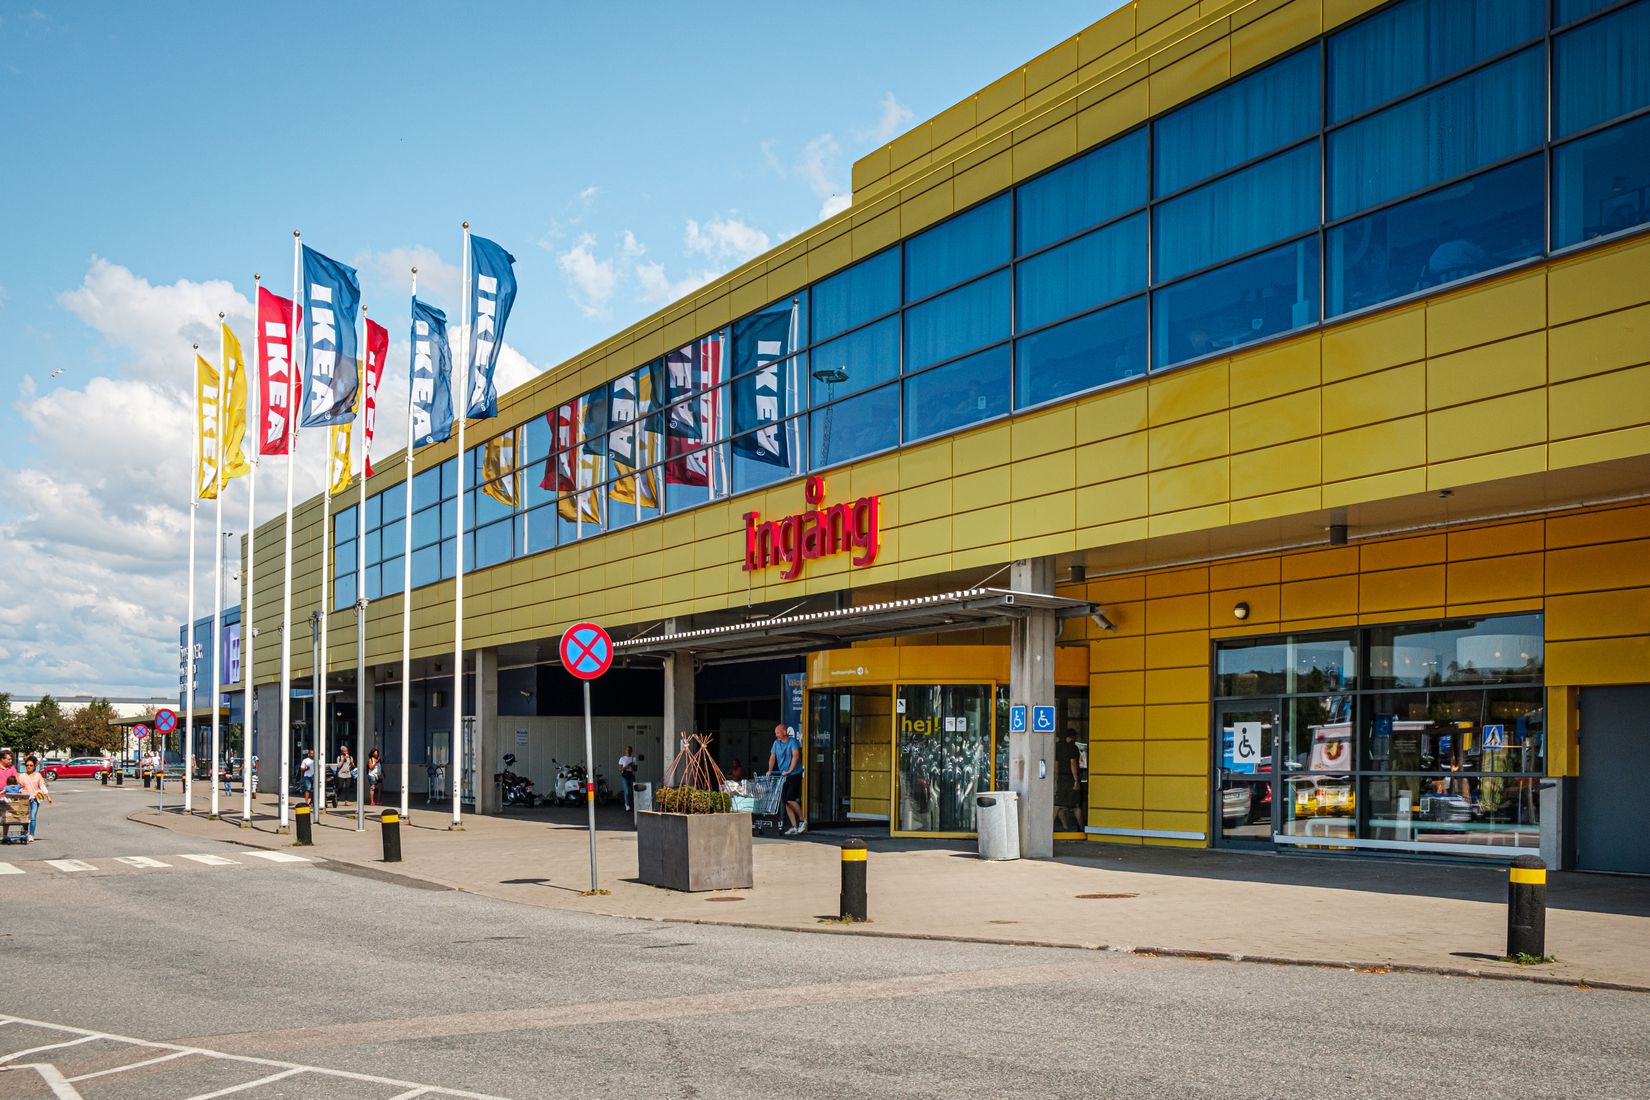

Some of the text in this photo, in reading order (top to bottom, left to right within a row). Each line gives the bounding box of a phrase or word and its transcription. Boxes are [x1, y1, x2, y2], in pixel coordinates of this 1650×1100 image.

[265, 321, 288, 444] IKEA
[311, 283, 336, 417] IKEA
[412, 320, 433, 441] IKEA
[471, 273, 497, 407] IKEA
[202, 384, 218, 490] IKEA
[742, 476, 878, 580] Ingång
[902, 715, 939, 736] hej!
